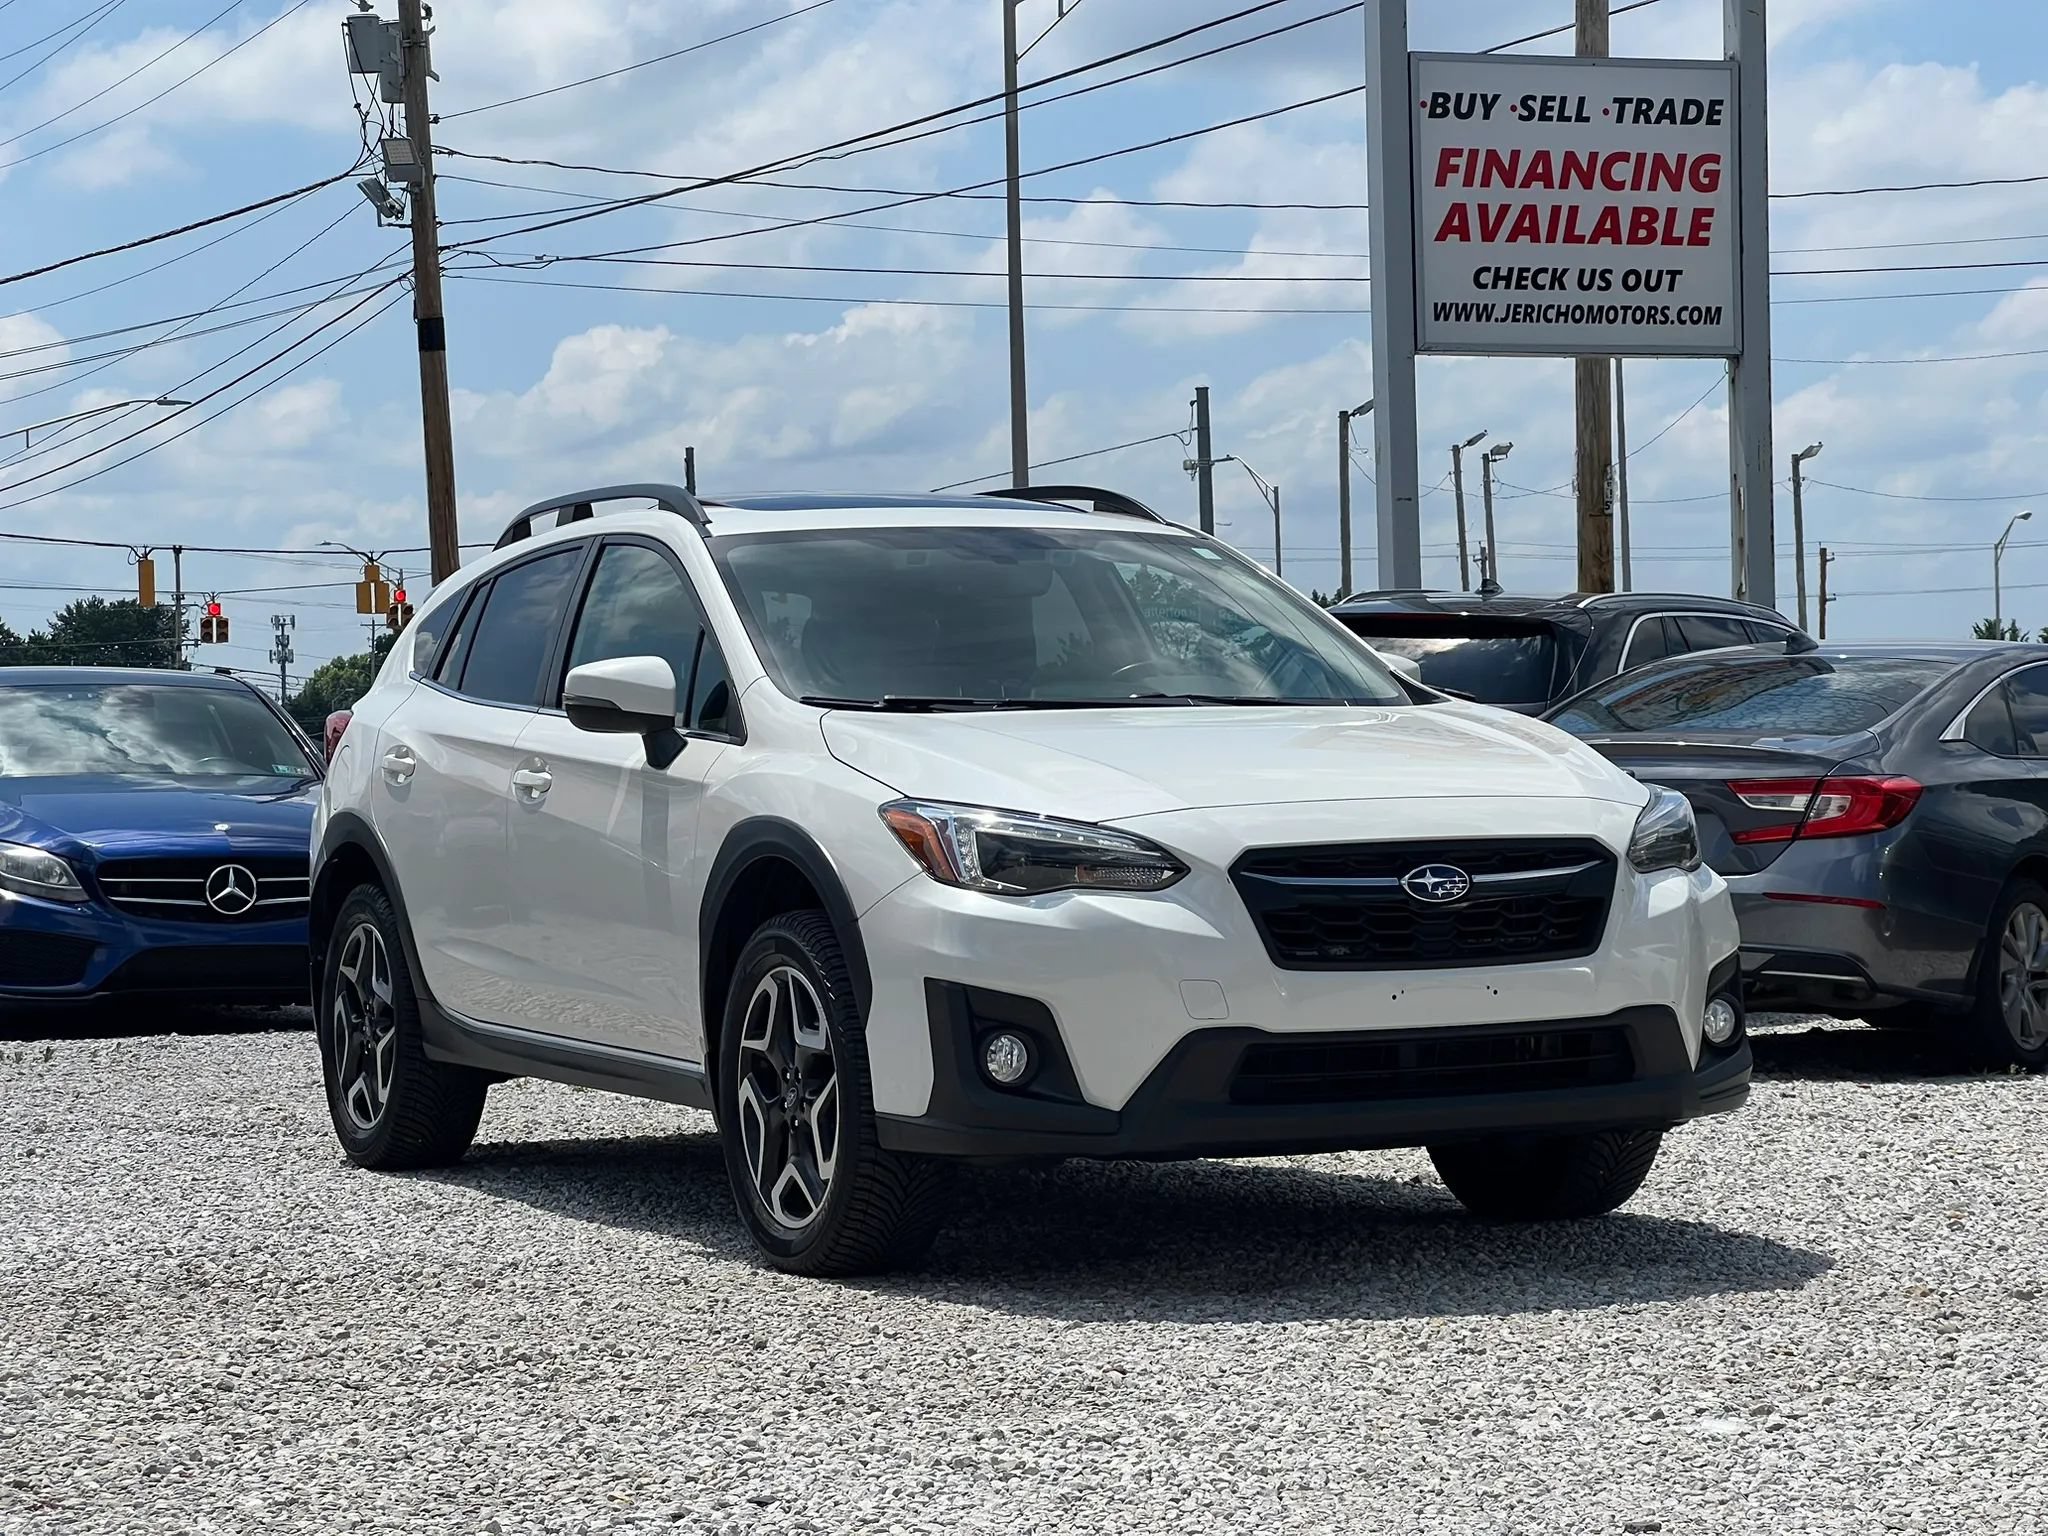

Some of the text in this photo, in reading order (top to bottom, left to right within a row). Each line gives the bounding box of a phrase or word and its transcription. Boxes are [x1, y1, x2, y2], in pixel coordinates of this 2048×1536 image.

[1427, 91, 1725, 126] BUY SELL TRADE
[1434, 147, 1722, 193] FINANCING
[1434, 202, 1715, 247] AVAILABLE
[1472, 265, 1684, 293] CHECK US OUT
[1433, 301, 1723, 326] WWW.JERICHOMOTORS.COM
